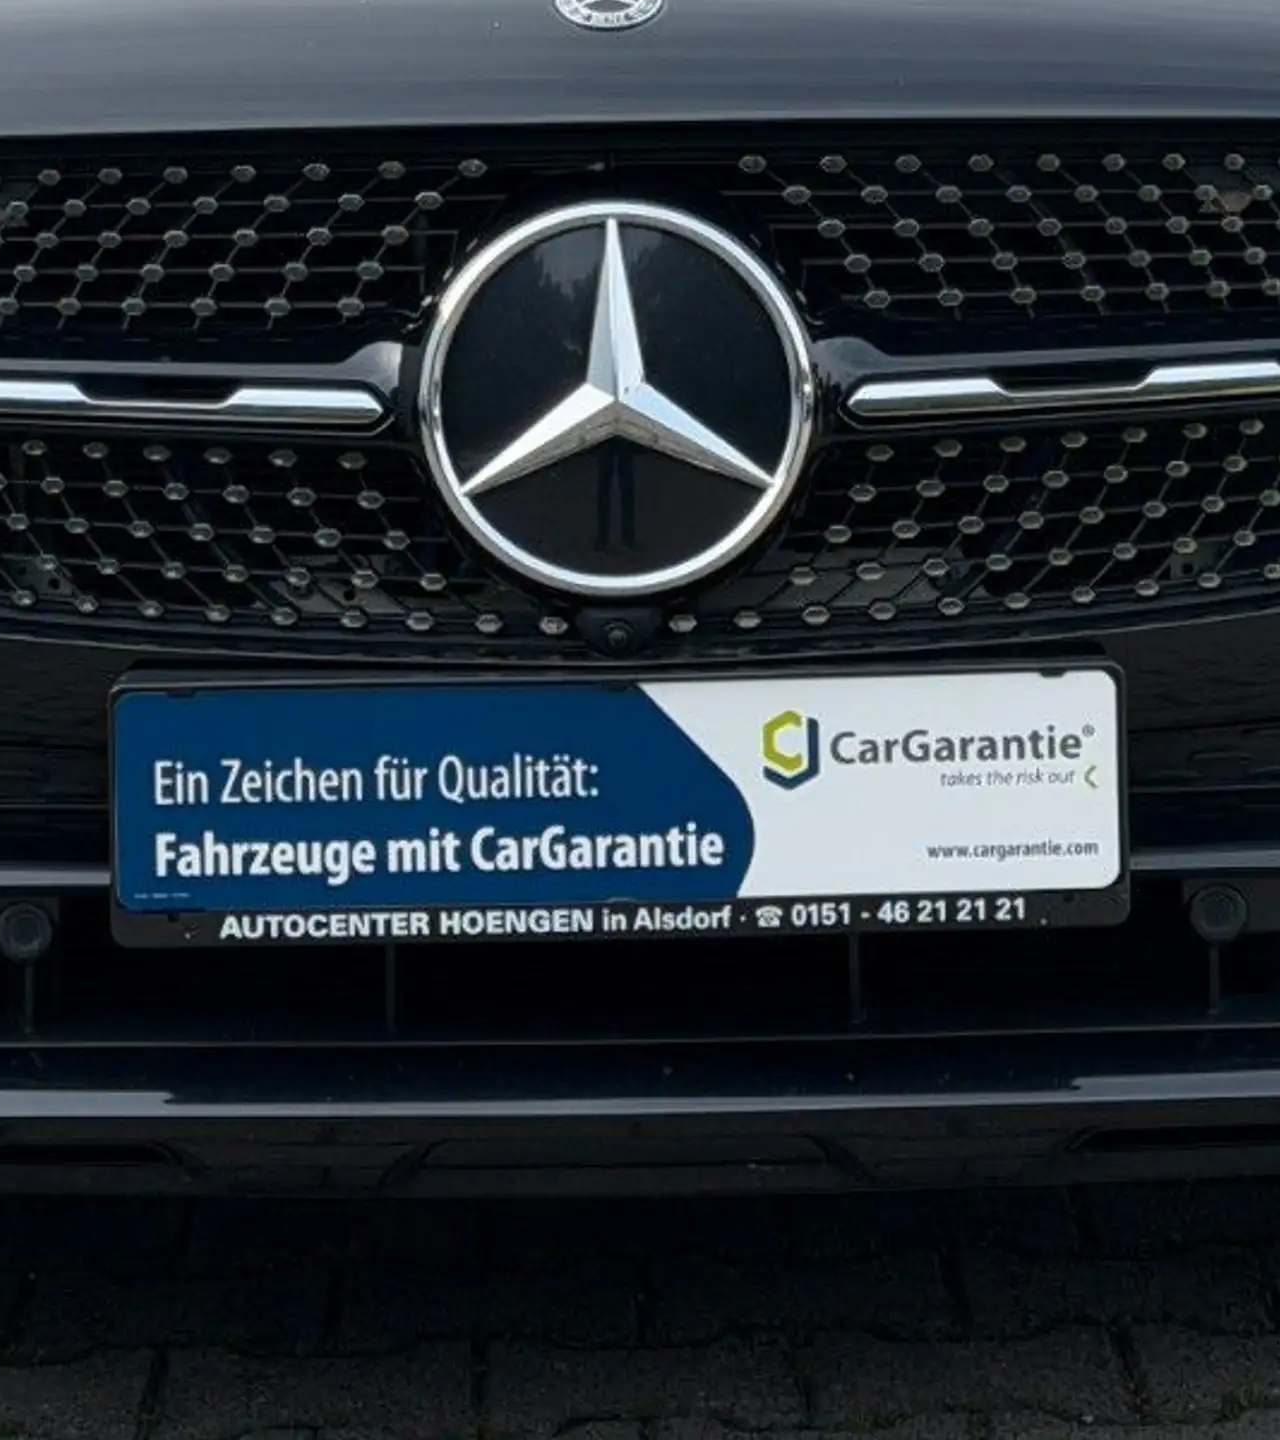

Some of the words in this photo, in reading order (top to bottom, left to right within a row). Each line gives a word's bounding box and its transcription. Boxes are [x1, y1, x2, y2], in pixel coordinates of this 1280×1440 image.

[153, 760, 209, 805] Ein
[220, 756, 363, 804] Zeichen
[374, 754, 428, 801] für
[437, 751, 599, 804] Qualität:
[940, 769, 983, 787] takes
[986, 767, 1014, 786] the
[1016, 764, 1044, 784] risk
[1048, 766, 1076, 784] out
[154, 829, 376, 887] Fahrzeuge
[386, 826, 462, 872] mit
[470, 820, 725, 871] CarGarantie
[926, 838, 1099, 861] www.cargarantie.com
[219, 911, 431, 939] AUTOCENTER
[439, 907, 594, 936] HOENGEN
[602, 908, 627, 931] in
[632, 905, 733, 931] Alsdorf
[790, 902, 852, 927] 0151
[876, 901, 911, 924] 46
[916, 900, 947, 923] 21
[956, 898, 986, 922] 21
[995, 896, 1025, 921] 21
